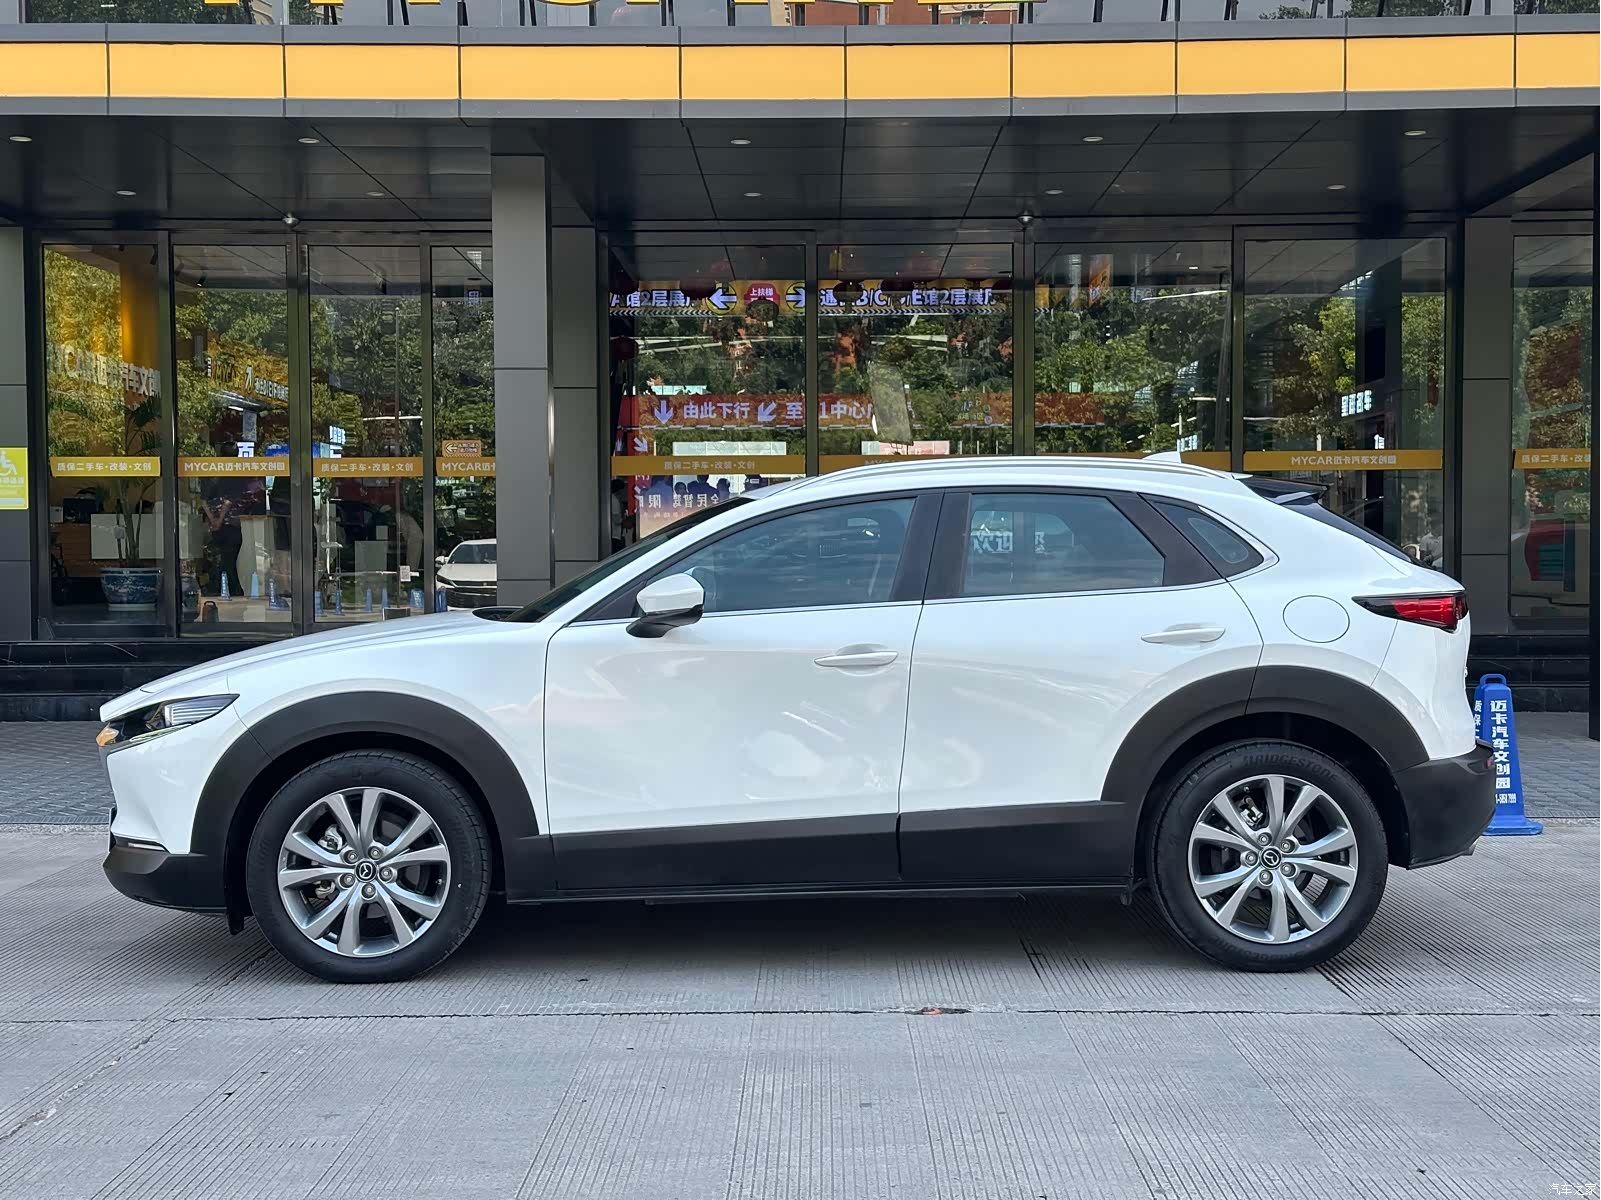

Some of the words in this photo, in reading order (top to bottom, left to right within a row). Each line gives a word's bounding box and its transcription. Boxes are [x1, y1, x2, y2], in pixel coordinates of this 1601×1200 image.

[683, 402, 750, 420] 由此下行
[1490, 700, 1511, 789] 迈卡汽车文创园
